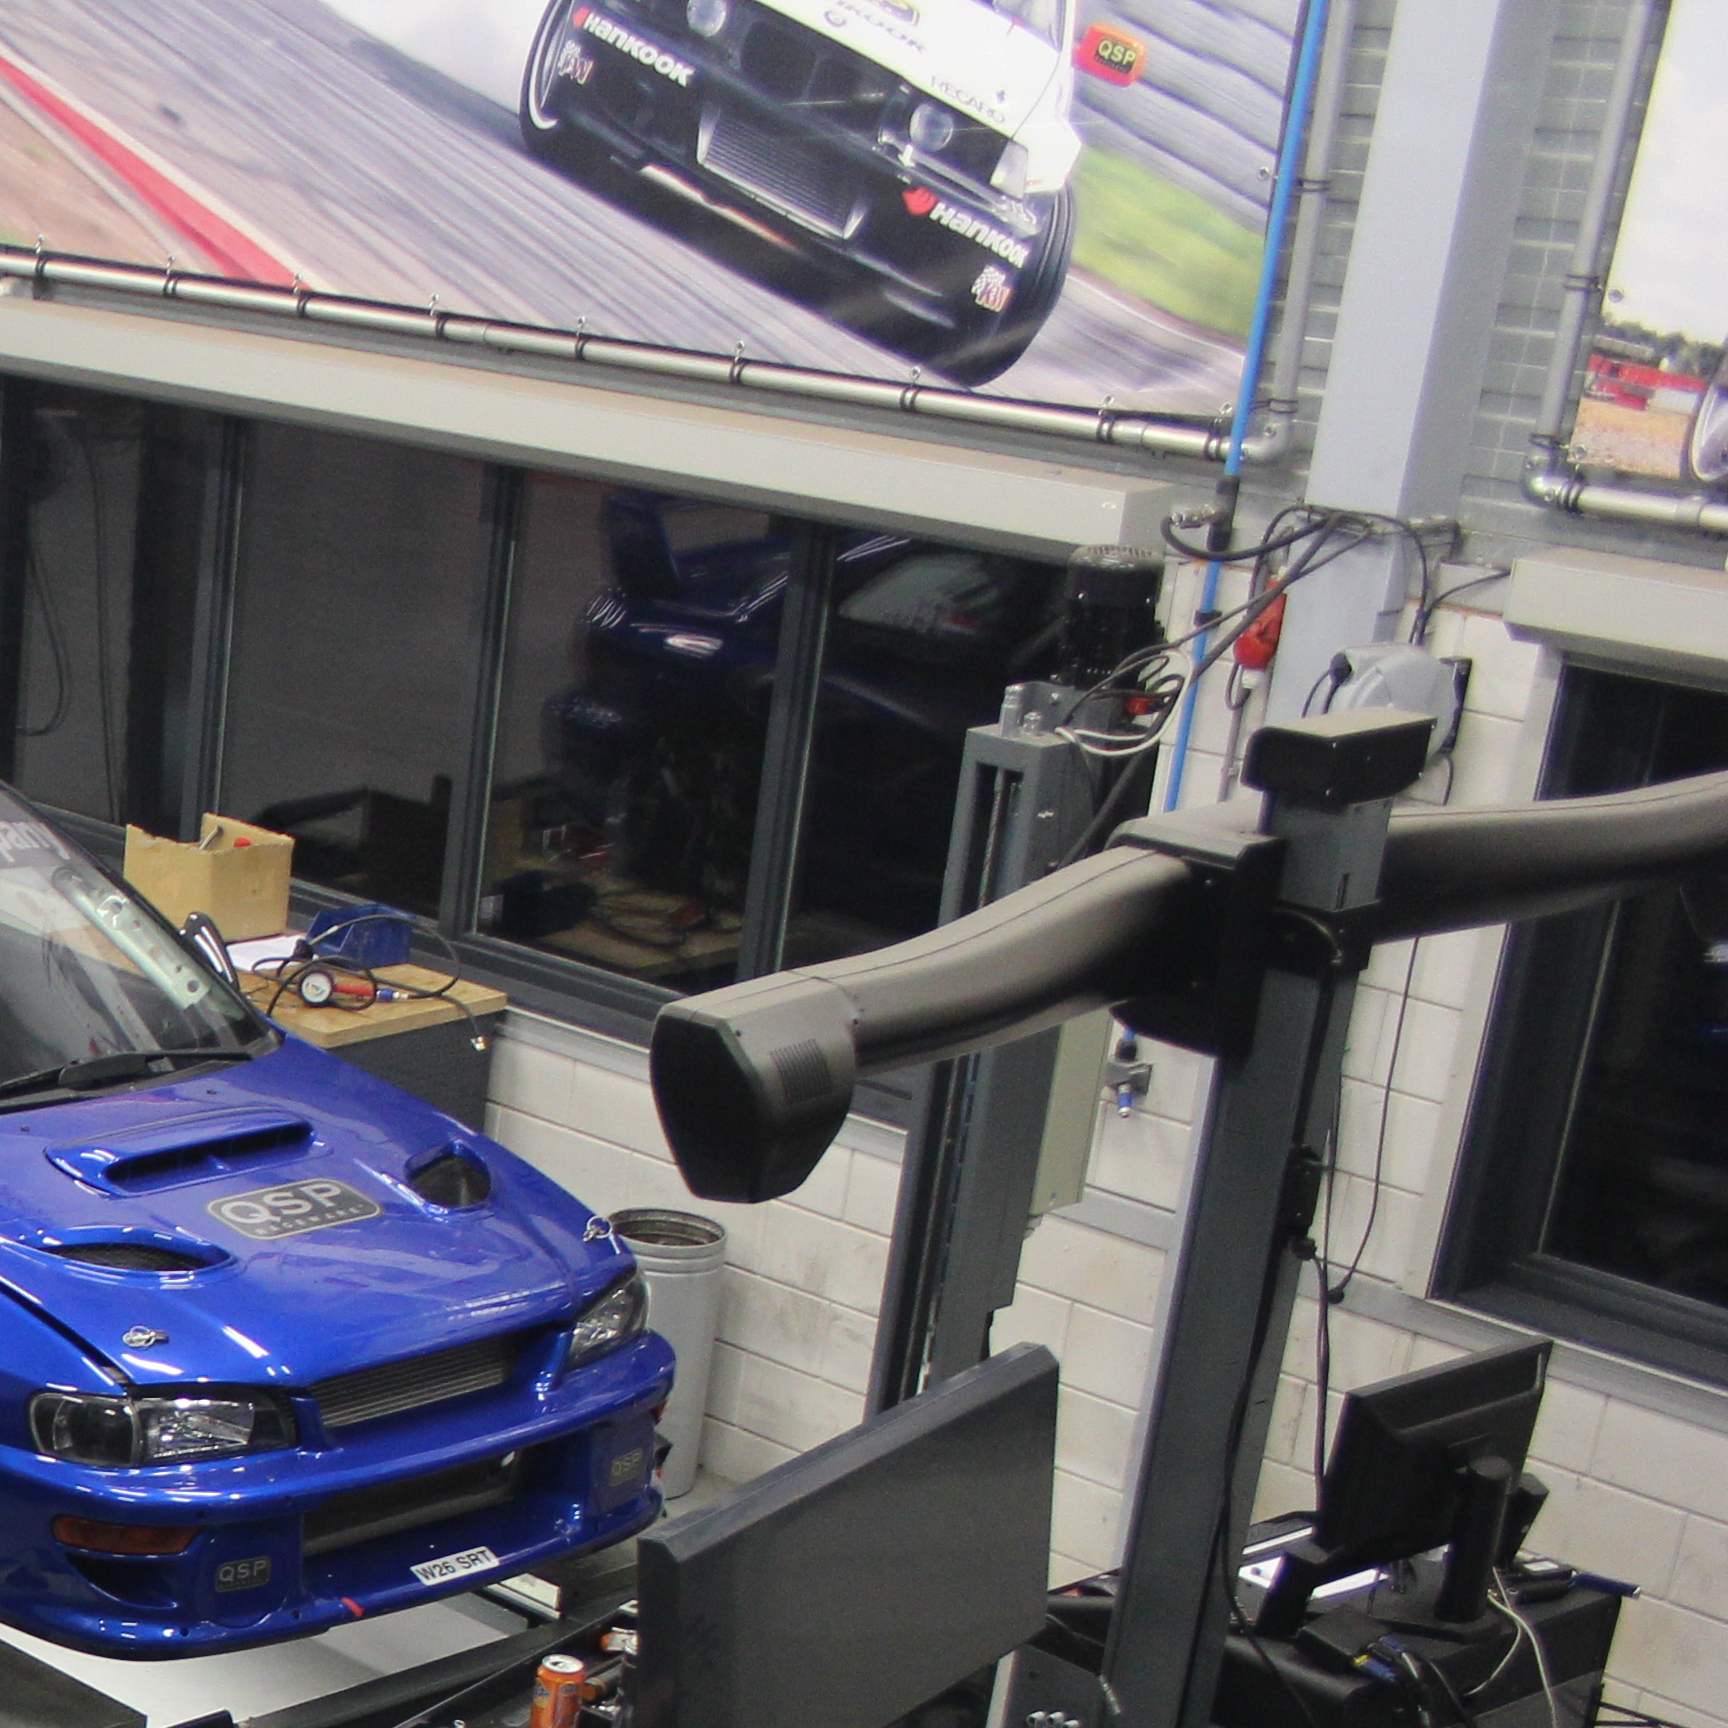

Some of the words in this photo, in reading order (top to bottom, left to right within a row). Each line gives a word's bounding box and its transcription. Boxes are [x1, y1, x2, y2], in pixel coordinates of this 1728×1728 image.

[1098, 40, 1136, 65] QSP
[930, 75, 1005, 124] RECARO
[221, 1183, 342, 1224] QSP
[219, 1560, 268, 1582] QSP
[415, 1562, 456, 1582] W26
[458, 1549, 494, 1571] SRT
